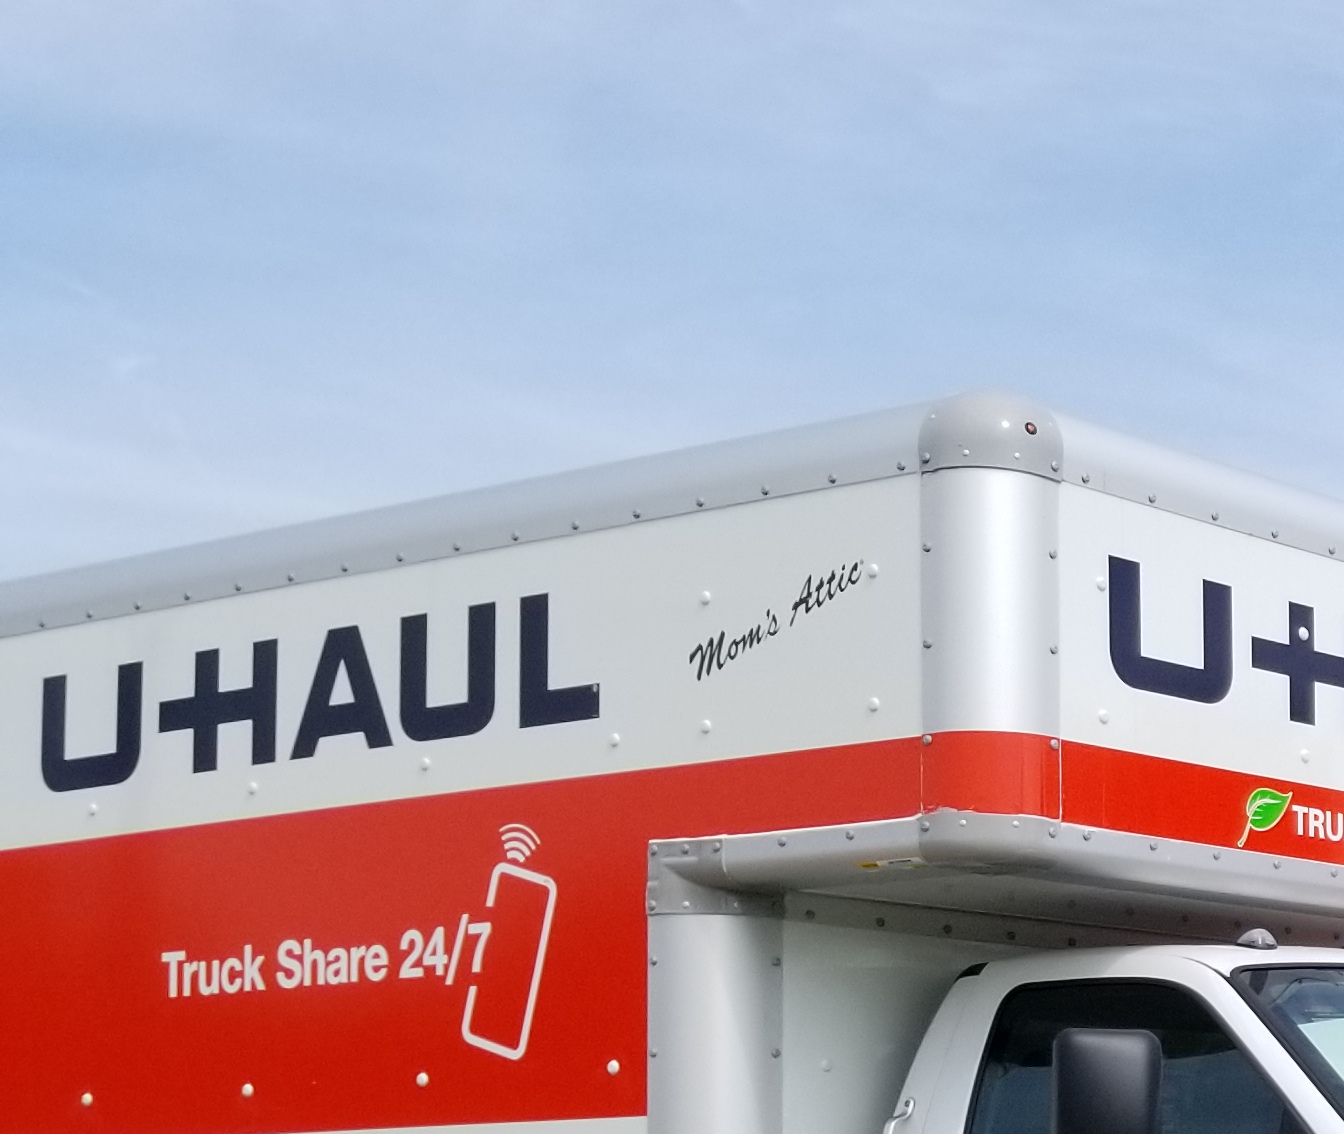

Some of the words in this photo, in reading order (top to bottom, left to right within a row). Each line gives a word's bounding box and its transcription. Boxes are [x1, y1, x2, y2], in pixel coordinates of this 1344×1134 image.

[689, 609, 780, 682] Mom's
[789, 562, 862, 628] Attic
[161, 944, 266, 998] Truck
[276, 938, 390, 990] Share
[398, 912, 491, 986] 24/7
